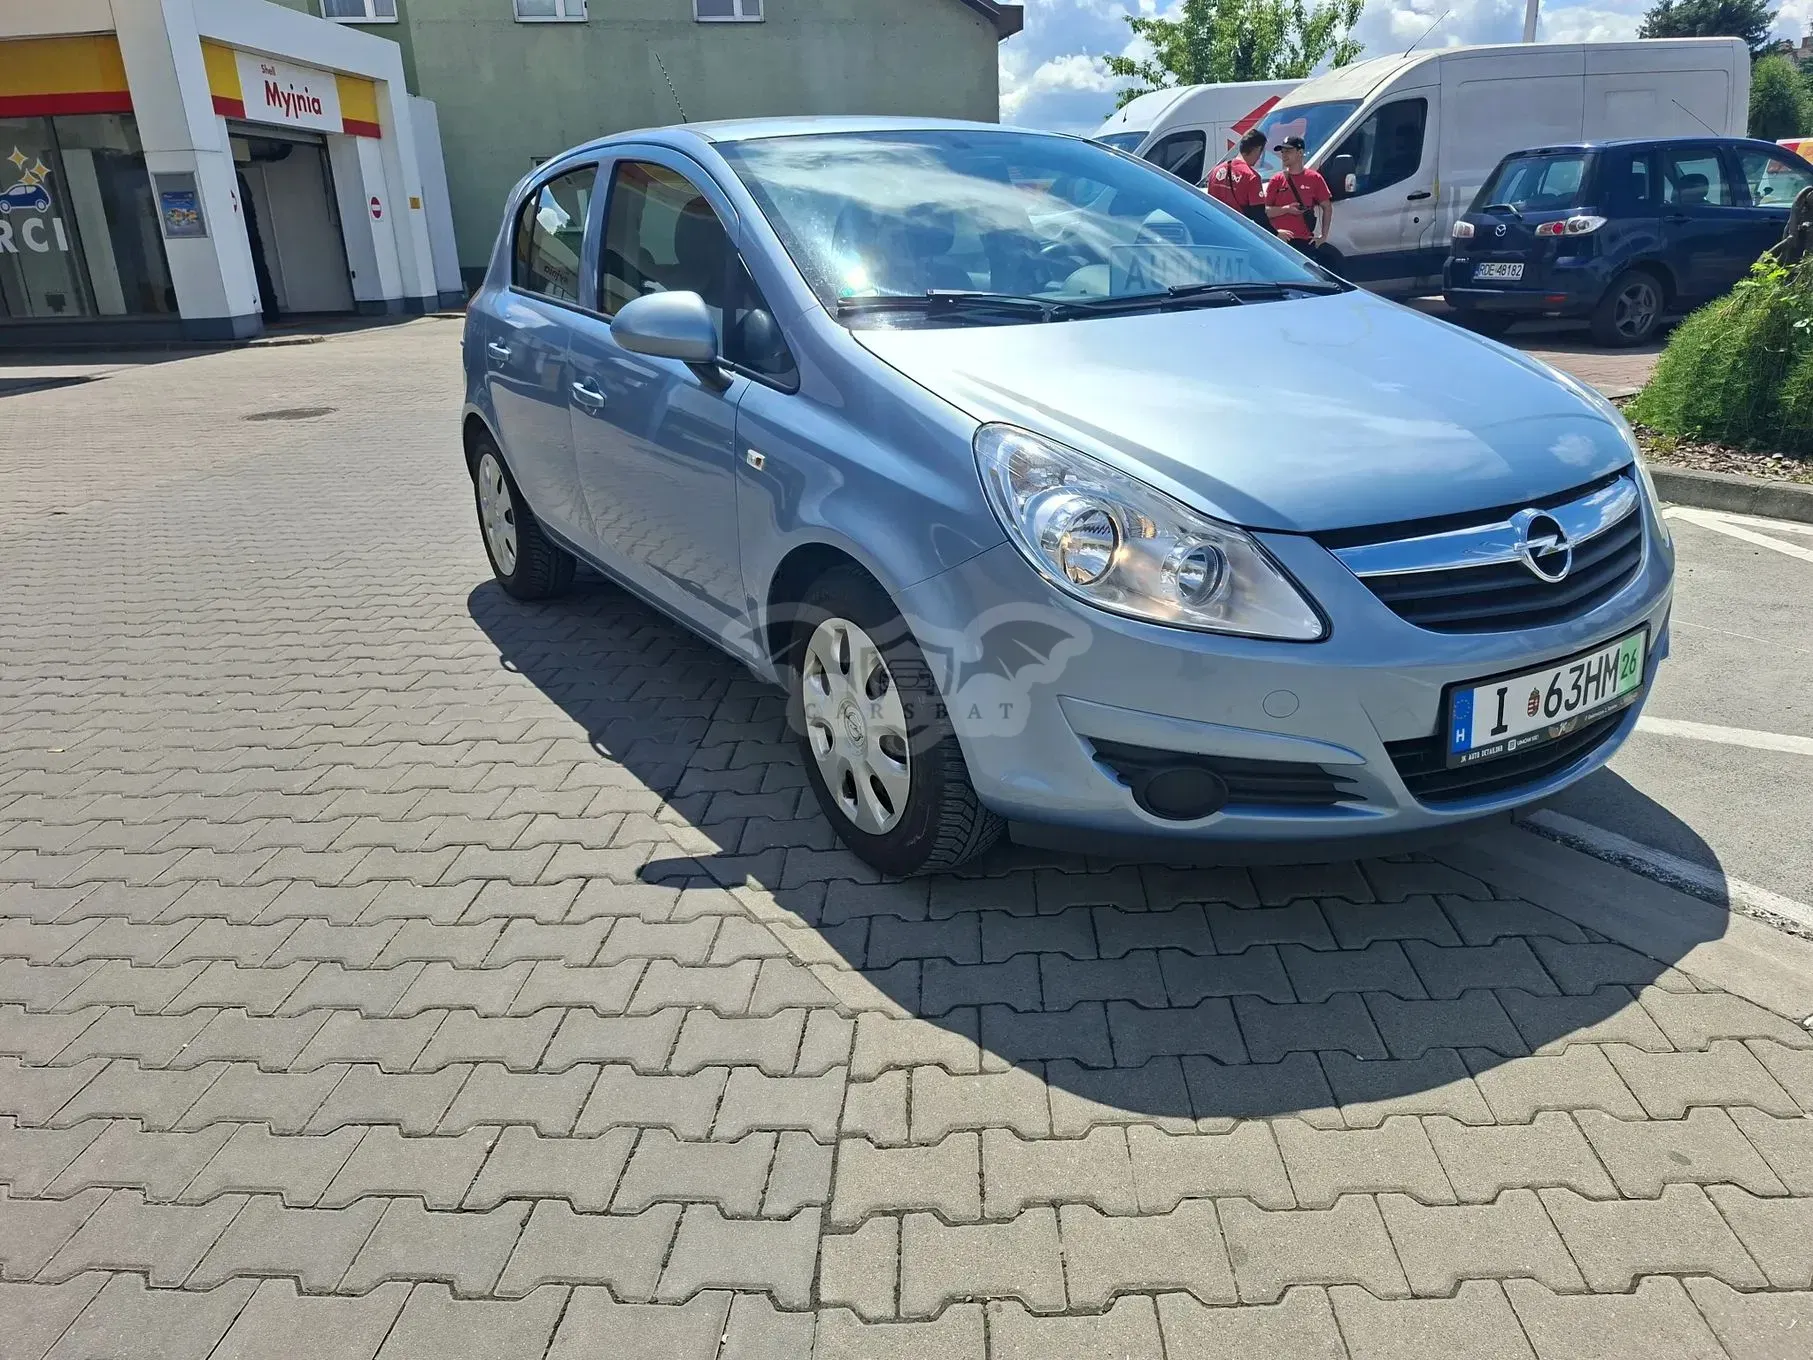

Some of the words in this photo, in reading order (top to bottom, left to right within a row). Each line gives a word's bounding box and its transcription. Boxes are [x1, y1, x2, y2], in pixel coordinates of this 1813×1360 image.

[261, 64, 276, 76] Shell
[265, 80, 322, 119] Myjnia
[1480, 264, 1495, 276] RDE
[1497, 264, 1522, 276] 48182
[1491, 687, 1508, 736] I
[1544, 648, 1621, 718] 63HM
[1620, 648, 1637, 681] 26
[1455, 728, 1465, 743] H
